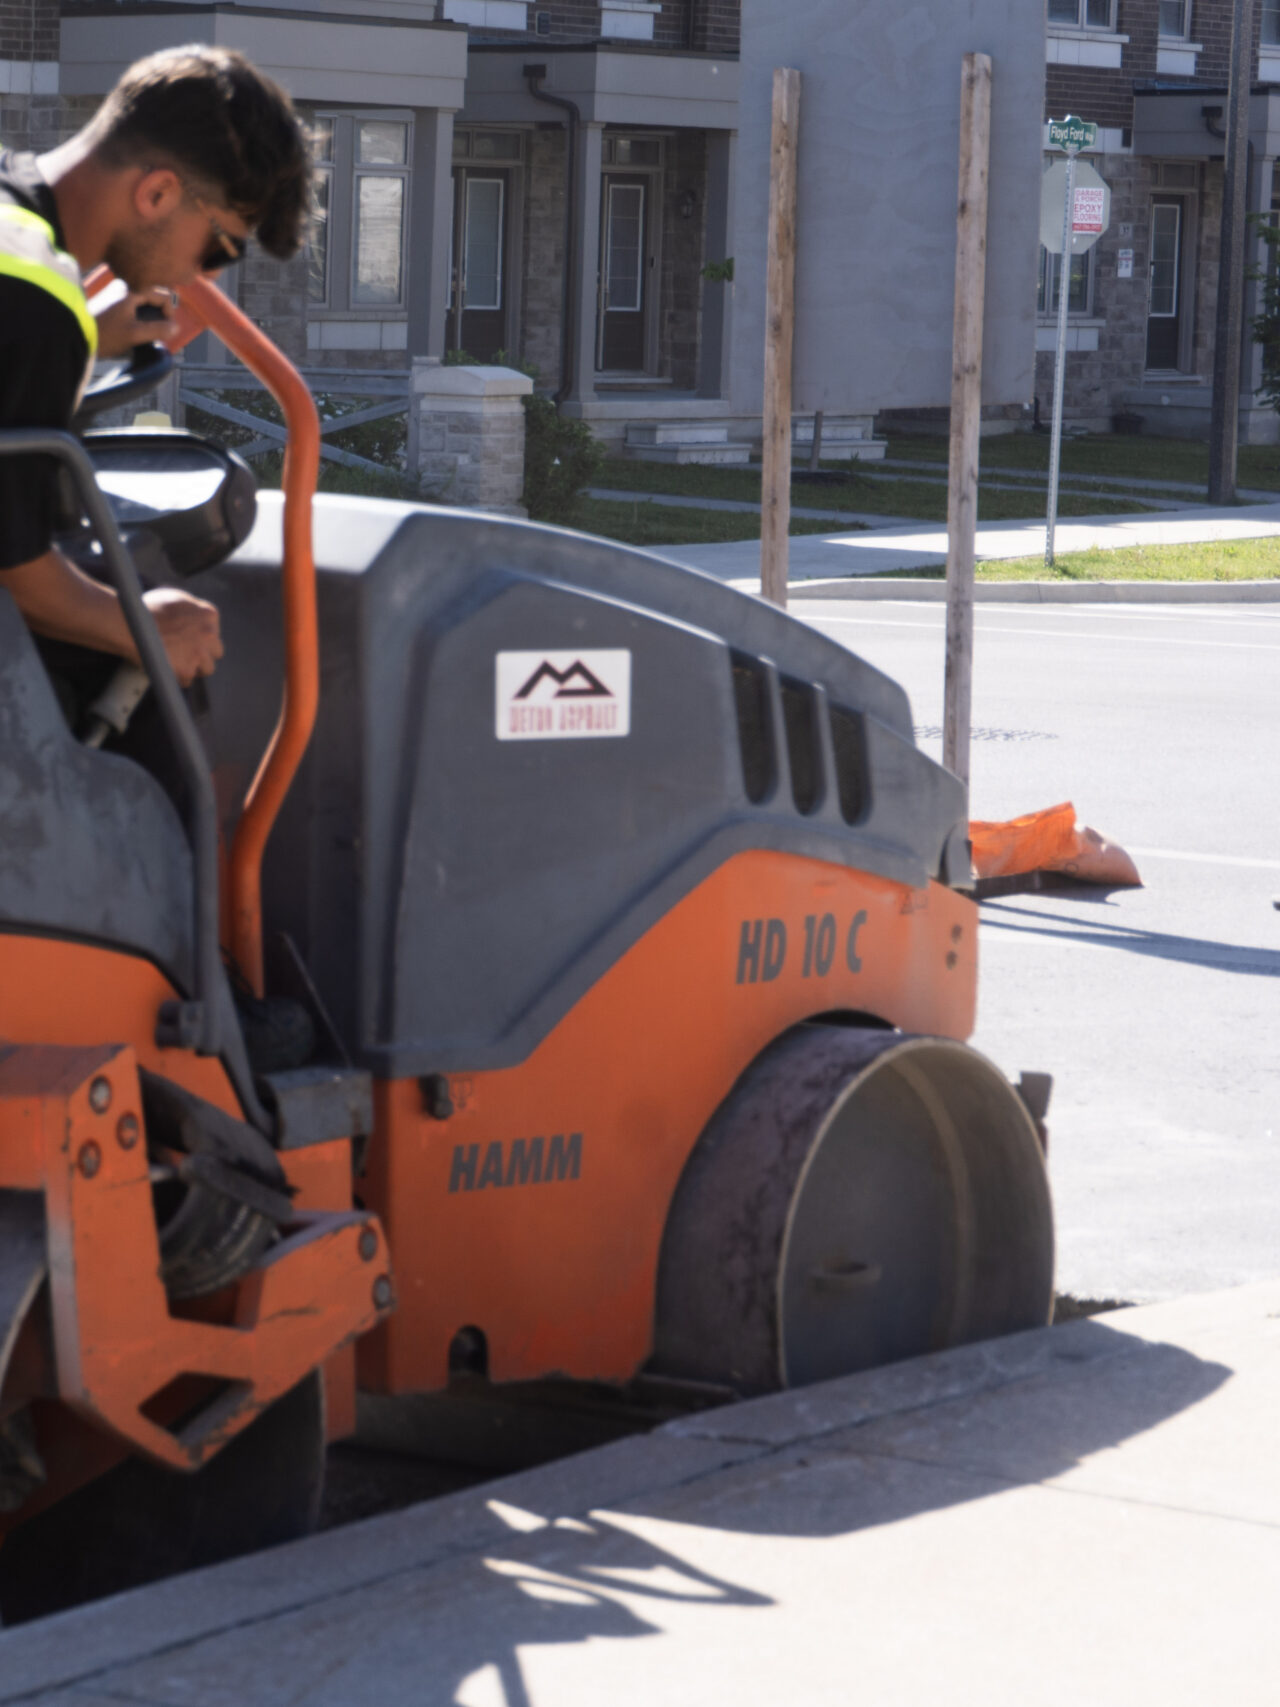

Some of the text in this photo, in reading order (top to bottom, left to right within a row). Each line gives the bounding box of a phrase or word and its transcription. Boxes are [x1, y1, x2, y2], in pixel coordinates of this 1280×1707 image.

[1051, 126, 1069, 142] Floyd
[1070, 127, 1085, 141] Ford
[1074, 203, 1102, 213] EPOXY
[735, 909, 868, 985] HD 10 C
[448, 1132, 583, 1194] HAMM
